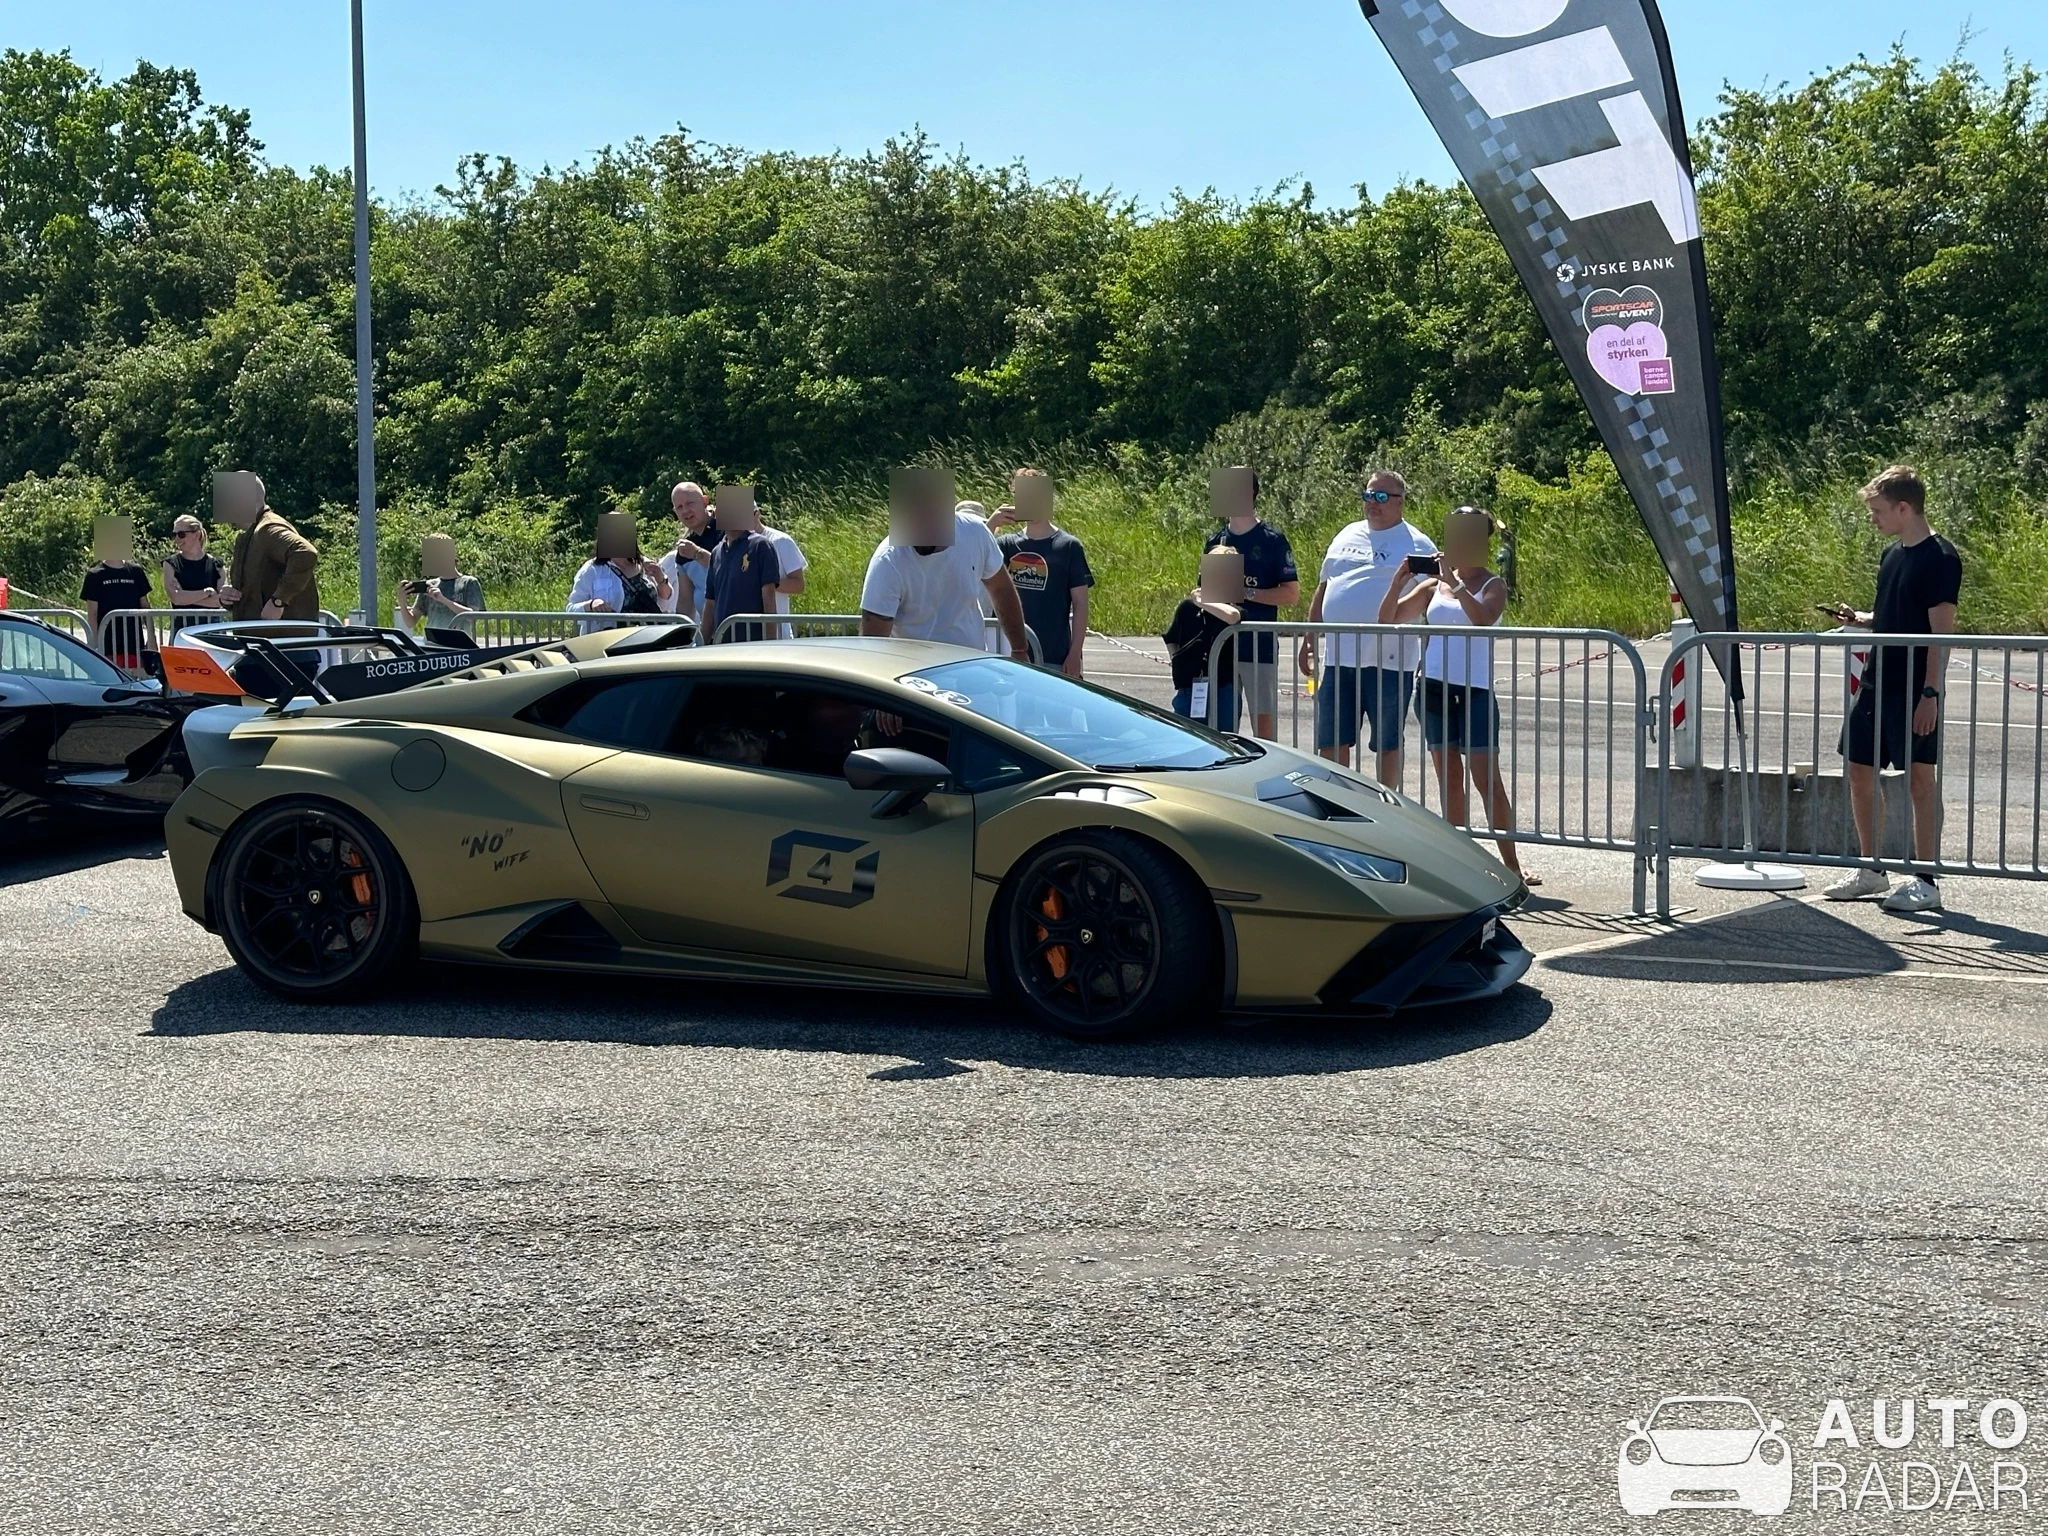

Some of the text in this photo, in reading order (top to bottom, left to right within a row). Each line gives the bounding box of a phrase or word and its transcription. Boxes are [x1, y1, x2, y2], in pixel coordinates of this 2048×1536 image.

[1438, 0, 1700, 245] IT
[1581, 257, 1675, 277] JYSKE BANK
[1591, 301, 1654, 313] SPORTSCAR
[1618, 308, 1655, 318] EVENT
[1606, 336, 1647, 348] en del af
[1607, 348, 1649, 361] styrken
[1014, 573, 1044, 585] Columbia
[174, 666, 212, 675] STO
[366, 654, 471, 678] ROGER DUBUIS
[493, 849, 530, 872] WIFE
[807, 852, 833, 886] 4
